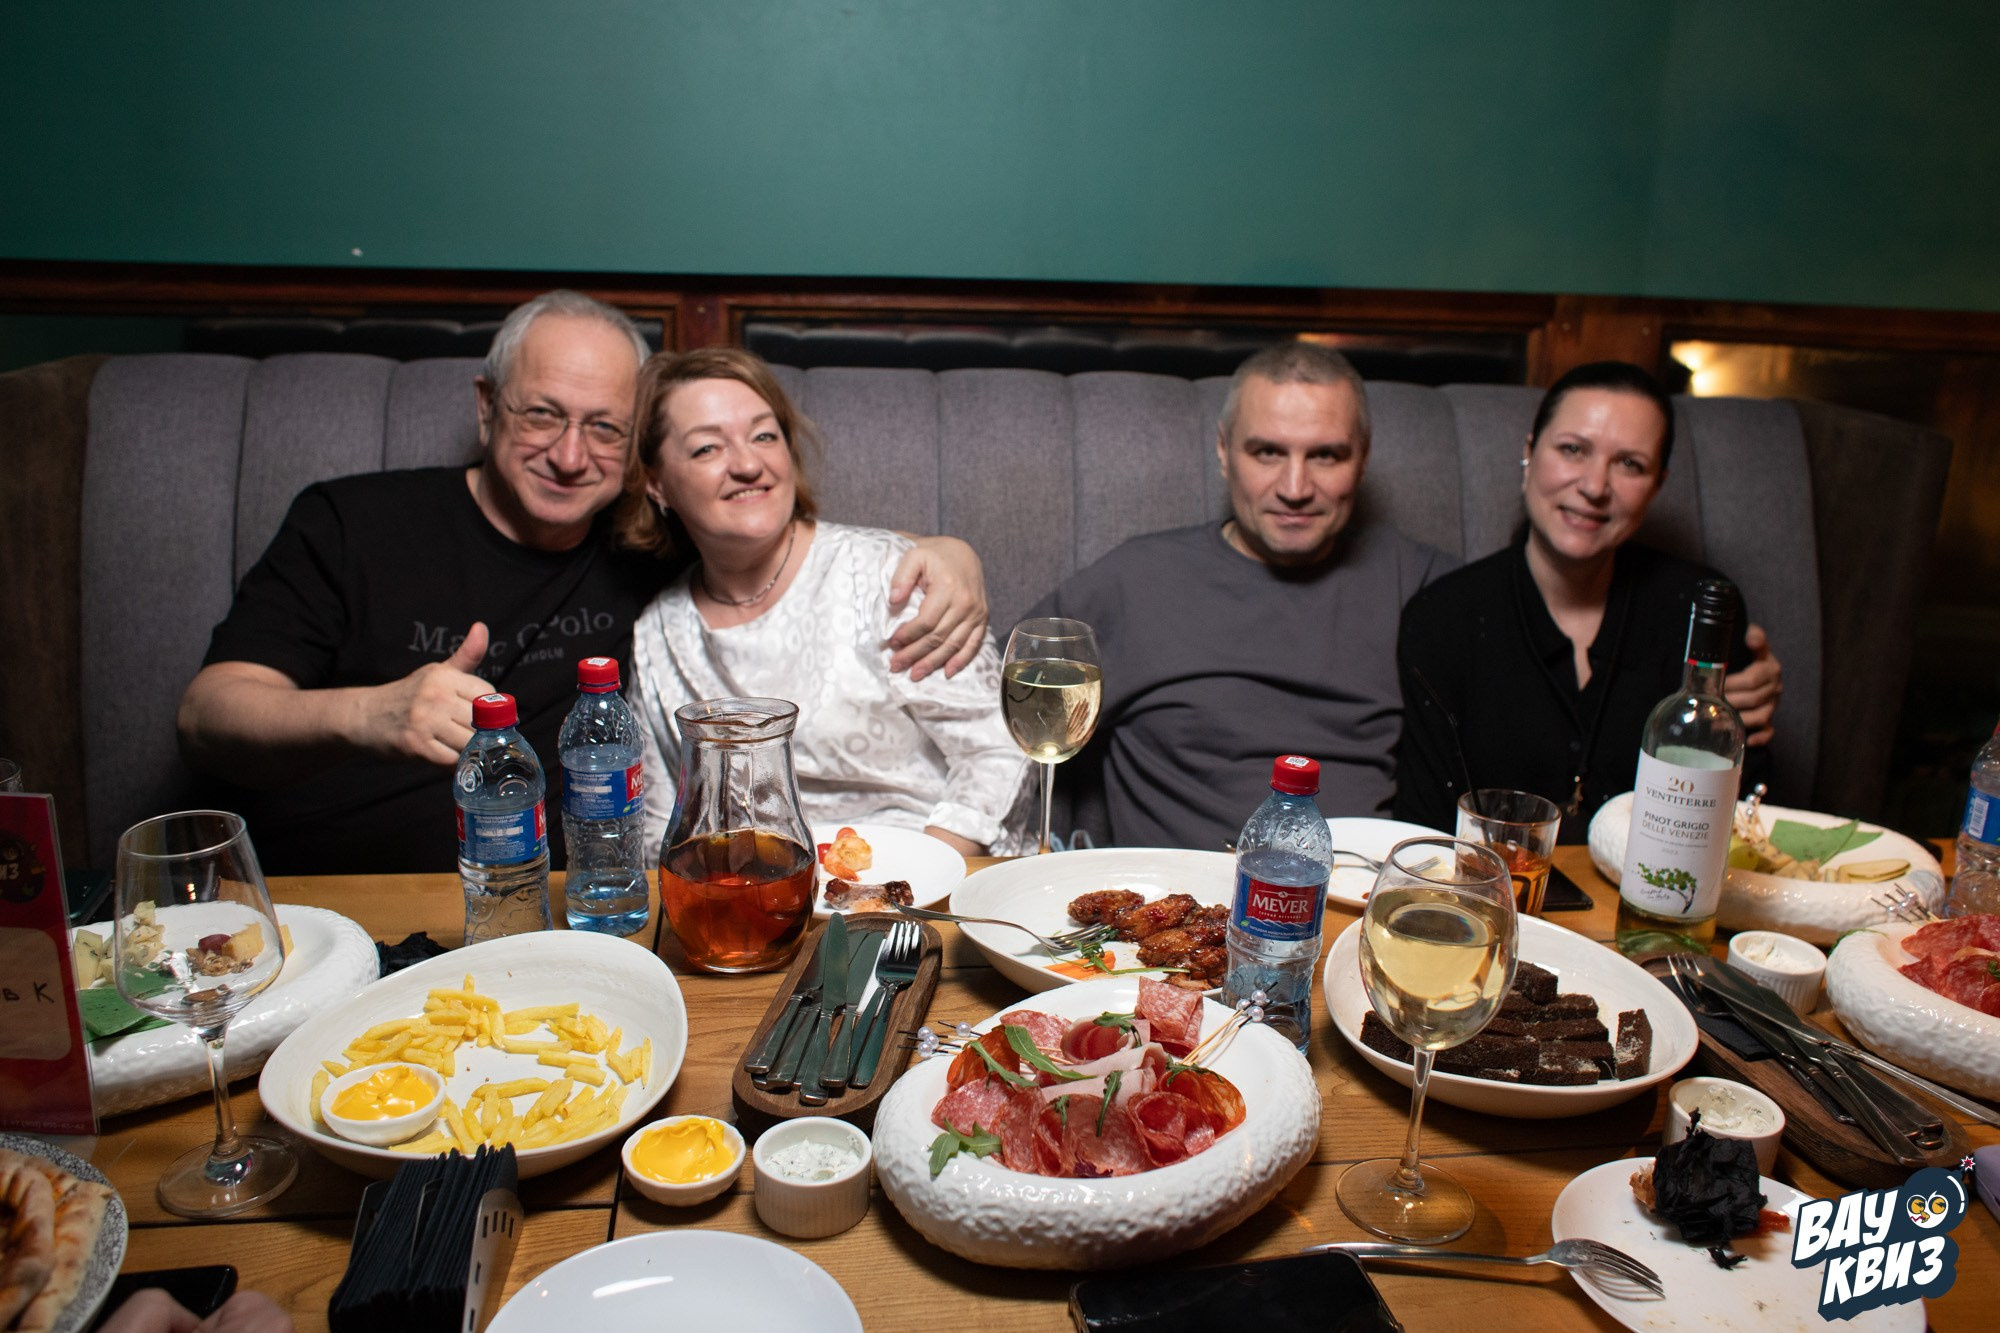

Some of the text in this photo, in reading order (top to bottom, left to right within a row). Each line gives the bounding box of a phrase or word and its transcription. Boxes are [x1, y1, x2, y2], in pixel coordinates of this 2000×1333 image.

[408, 621, 507, 658] Mac
[1667, 776, 1694, 794] 20
[1646, 786, 1718, 808] VENTITERRE
[1642, 820, 1665, 834] DELLE
[1669, 828, 1710, 840] VENEZIE
[1644, 810, 1710, 831] PINOT GRIGIO
[1252, 893, 1309, 914] MEVER
